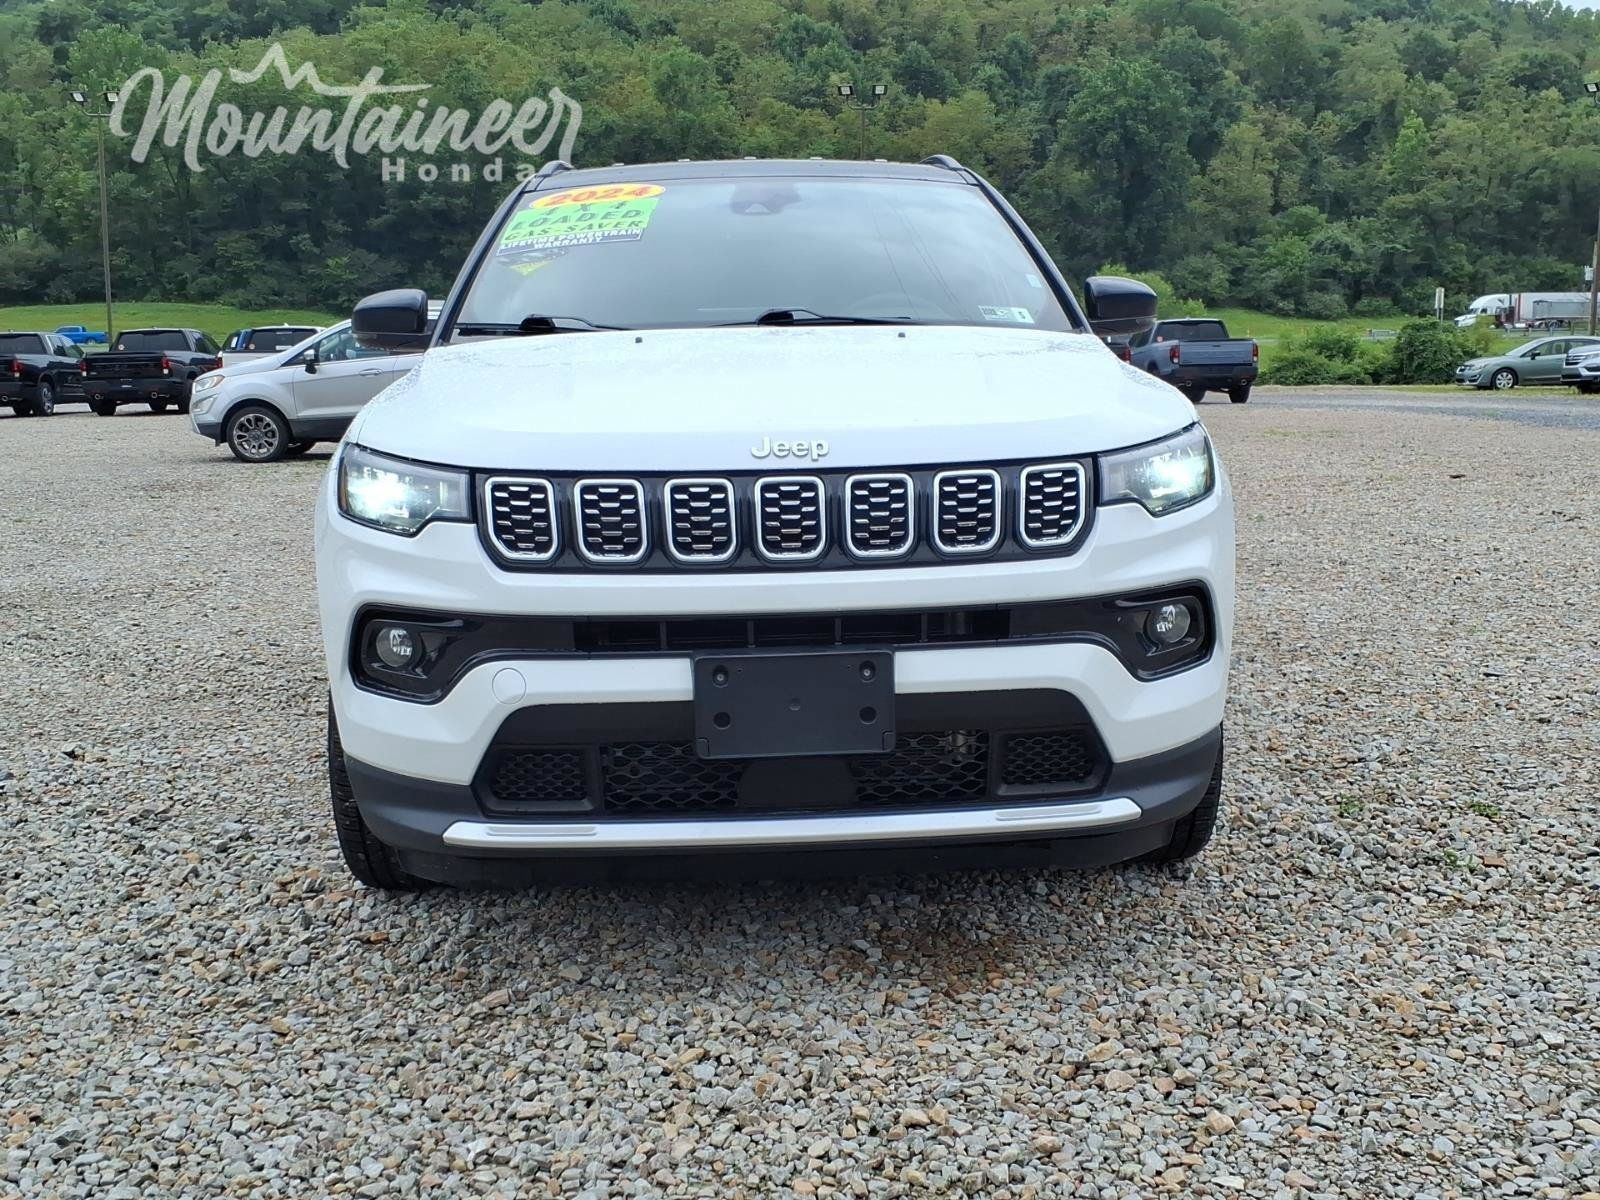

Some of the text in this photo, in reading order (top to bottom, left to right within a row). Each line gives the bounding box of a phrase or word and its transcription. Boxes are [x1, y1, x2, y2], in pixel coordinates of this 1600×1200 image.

[543, 186, 652, 206] 2024
[510, 208, 642, 231] LOADED
[499, 227, 641, 250] LIFETIME POWERTRAIN
[533, 236, 603, 250] WARRANTY
[751, 435, 830, 462] Jeep
